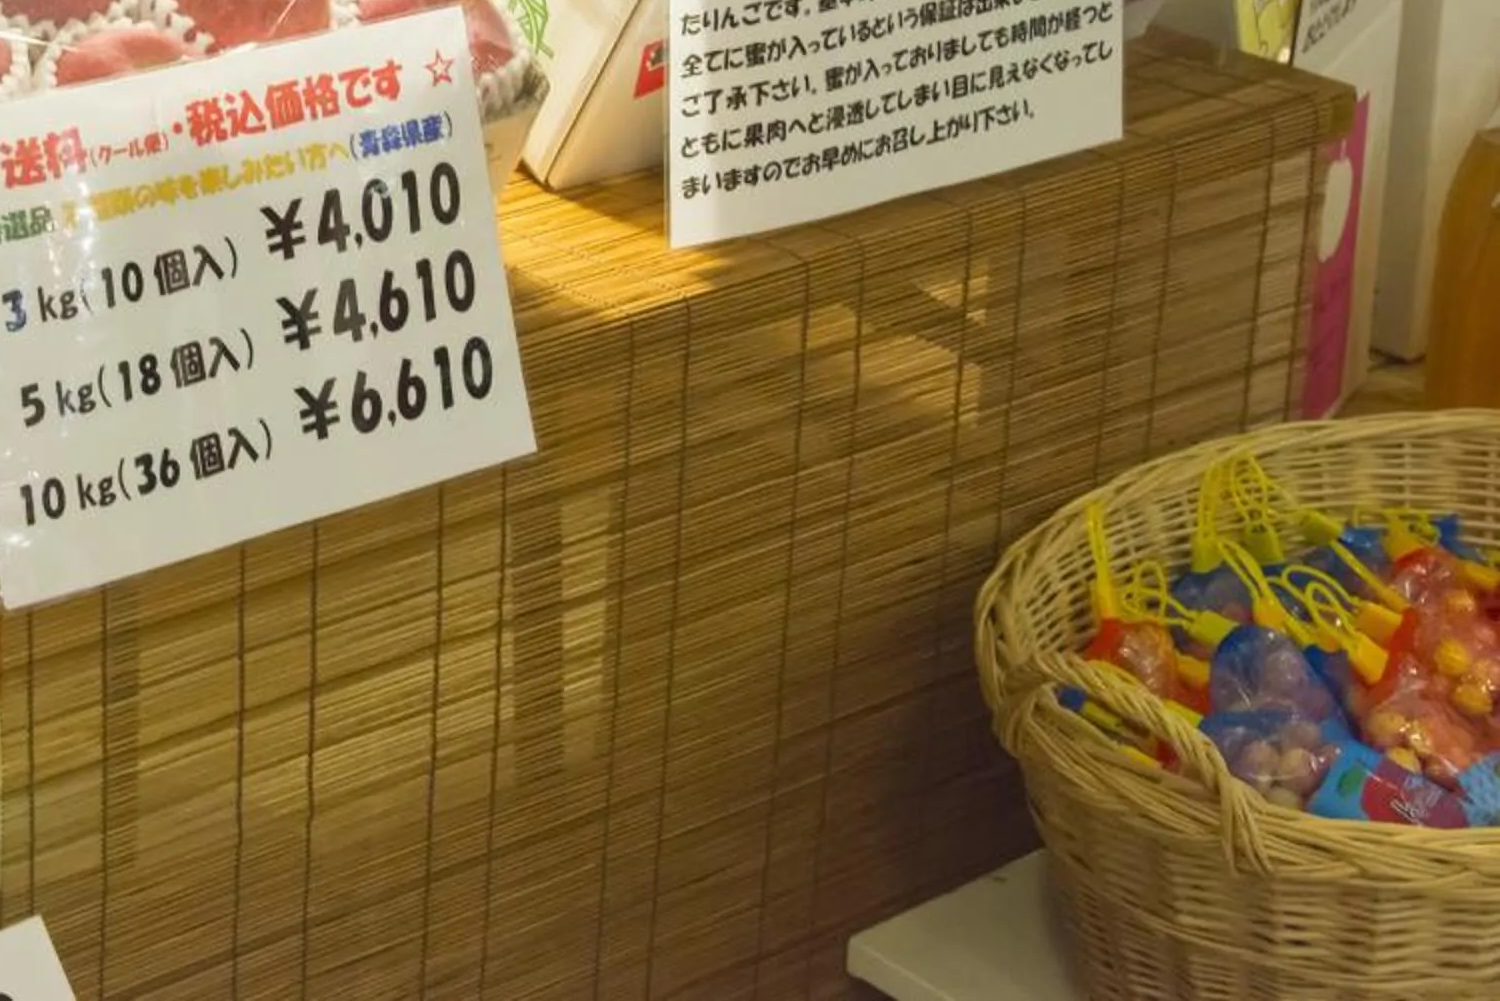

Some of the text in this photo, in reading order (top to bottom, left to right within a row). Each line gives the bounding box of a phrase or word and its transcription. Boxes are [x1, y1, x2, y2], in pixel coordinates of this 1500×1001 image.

[260, 161, 462, 261] ¥4,010
[276, 249, 475, 351] ¥4,610
[294, 336, 493, 440] ¥6,610
